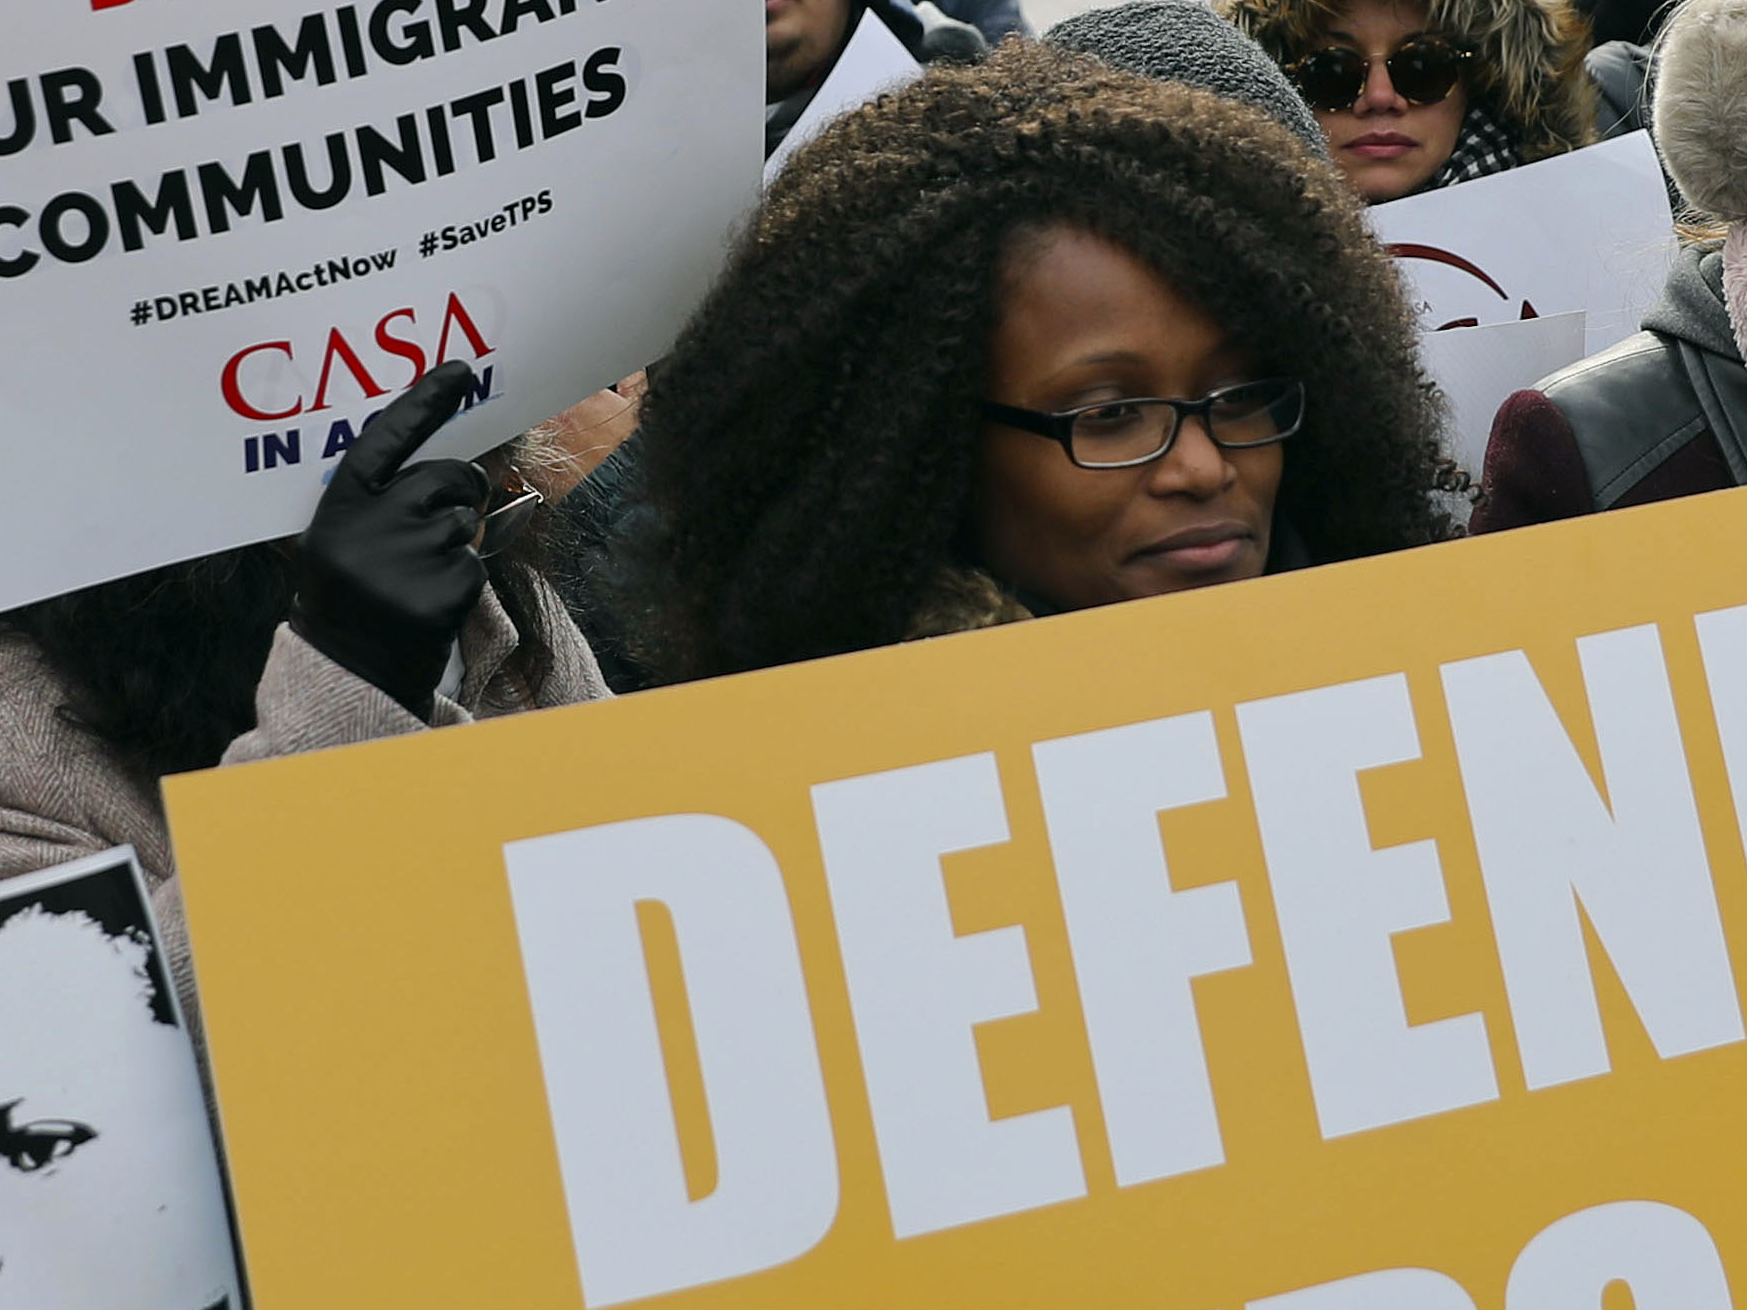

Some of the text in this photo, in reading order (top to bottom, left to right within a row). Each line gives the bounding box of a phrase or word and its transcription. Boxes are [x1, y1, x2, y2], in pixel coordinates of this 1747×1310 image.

[129, 190, 554, 326] #DREAMActNow #SaveTPS
[220, 292, 496, 421] CASA
[244, 429, 301, 474] IN
